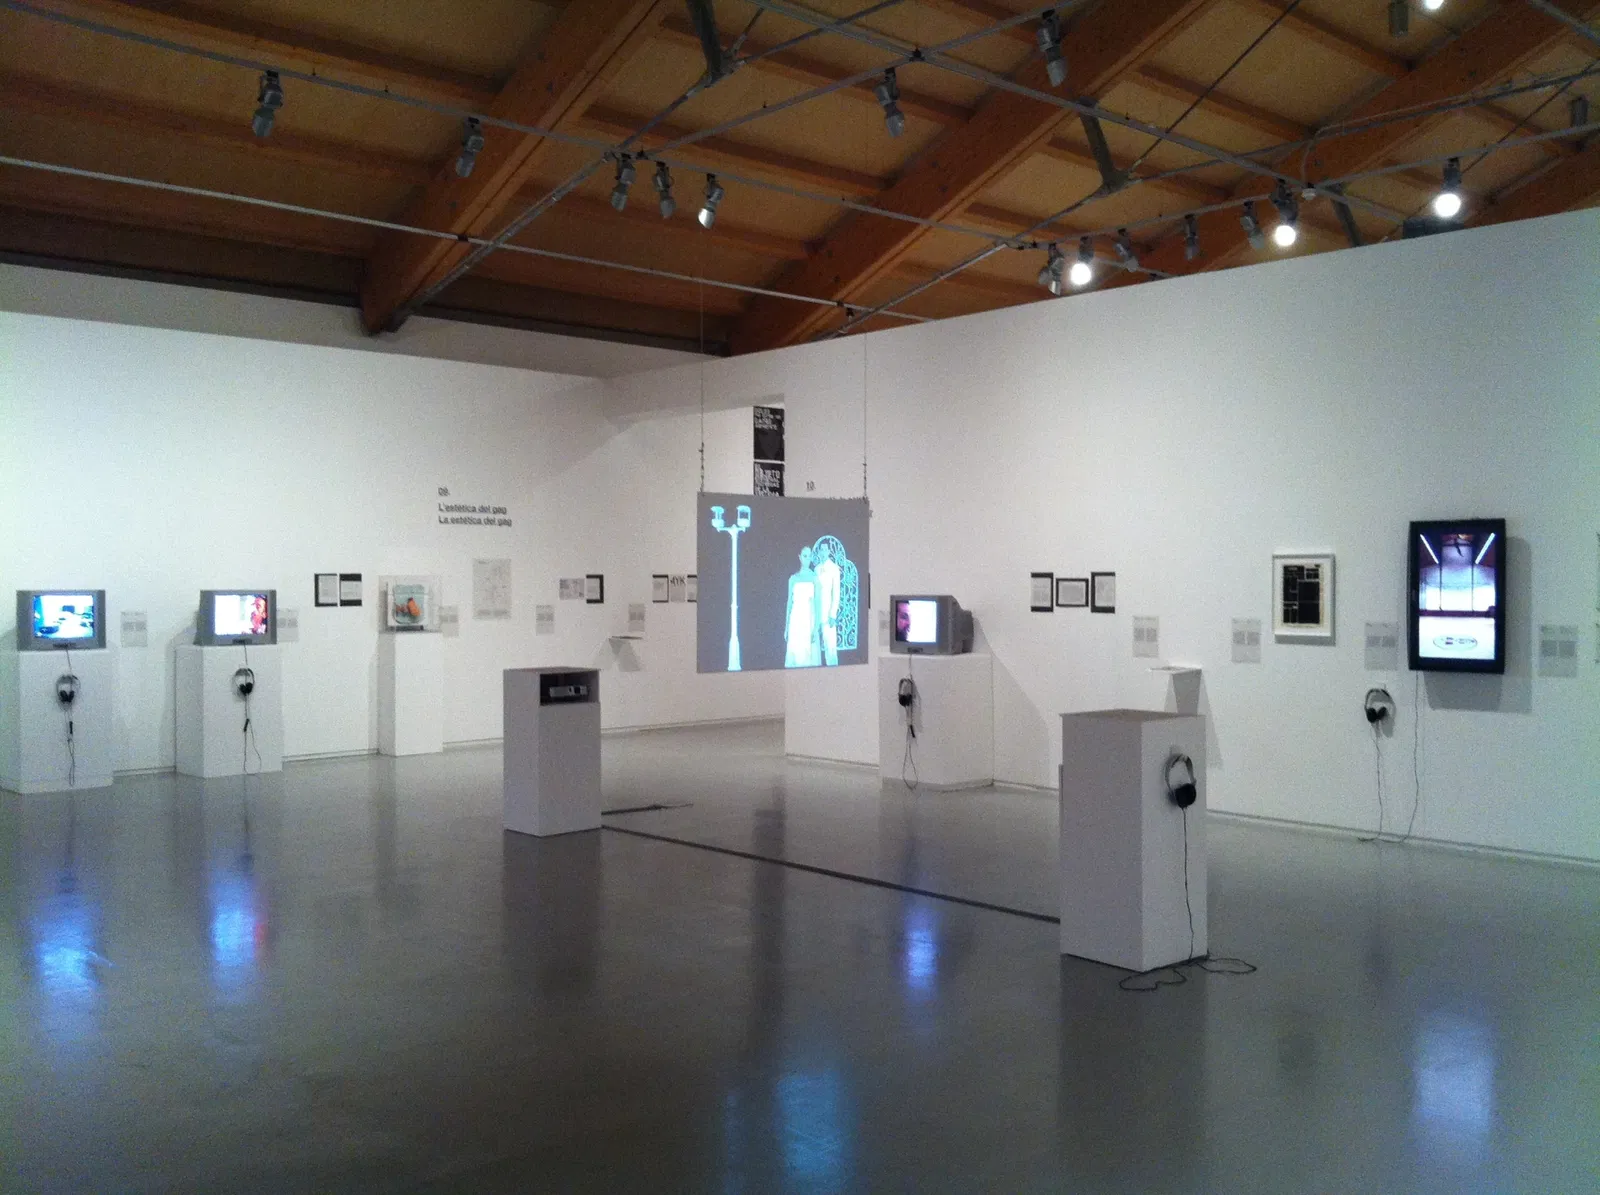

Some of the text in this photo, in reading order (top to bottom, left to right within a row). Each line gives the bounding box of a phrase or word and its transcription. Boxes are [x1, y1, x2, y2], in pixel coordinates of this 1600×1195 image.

[478, 504, 491, 513] del
[492, 506, 507, 515] gag
[438, 515, 449, 525] La
[483, 516, 496, 525] del
[497, 518, 512, 527] gag
